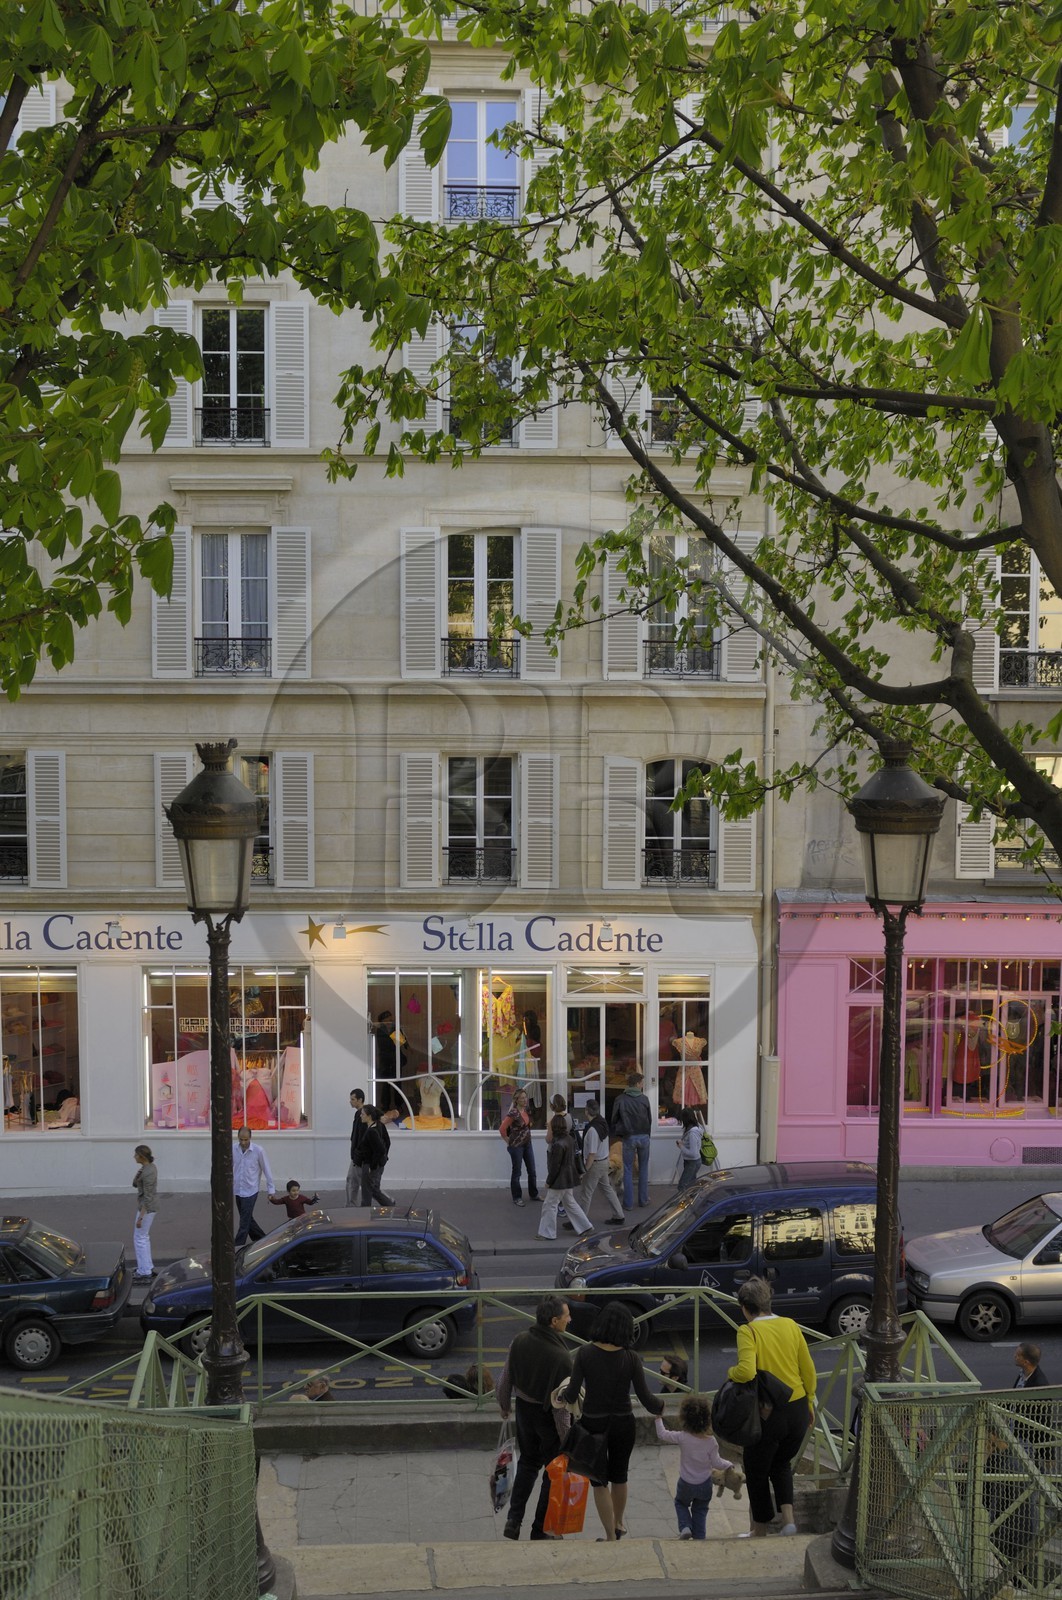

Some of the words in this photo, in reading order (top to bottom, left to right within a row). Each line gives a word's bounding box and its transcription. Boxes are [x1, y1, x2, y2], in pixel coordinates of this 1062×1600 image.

[0, 922, 32, 950] la
[43, 914, 183, 950] Cadente
[422, 915, 514, 951] Stella
[525, 915, 663, 952] Cadente
